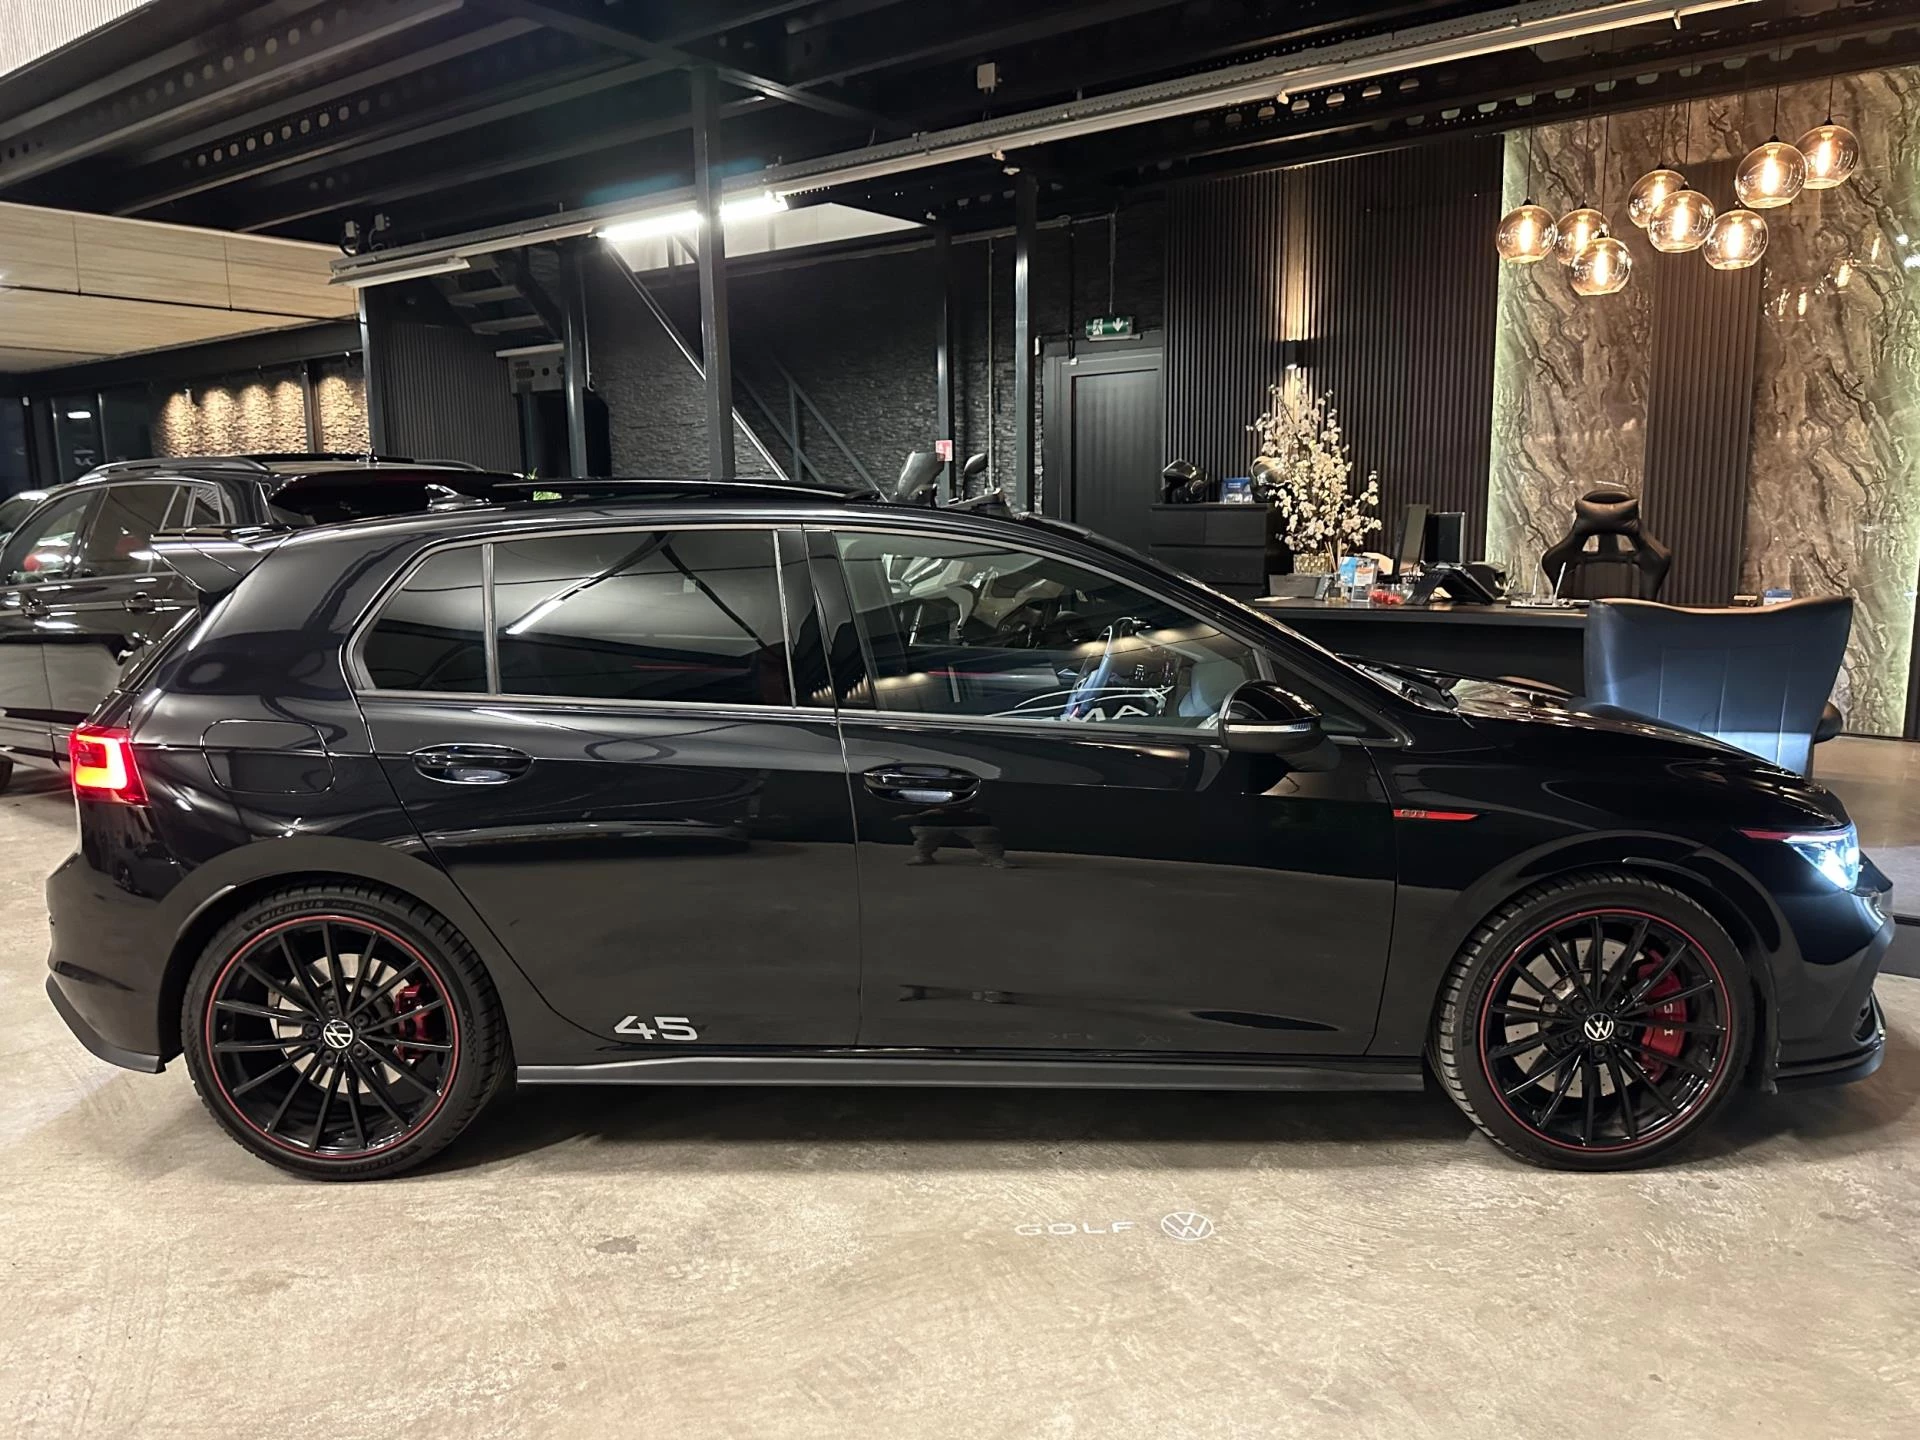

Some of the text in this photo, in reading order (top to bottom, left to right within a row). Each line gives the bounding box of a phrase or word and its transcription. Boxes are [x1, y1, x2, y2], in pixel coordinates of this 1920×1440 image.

[260, 901, 324, 920] MICHELIN
[614, 1015, 698, 1041] 45
[1014, 1221, 1135, 1236] GOLF
